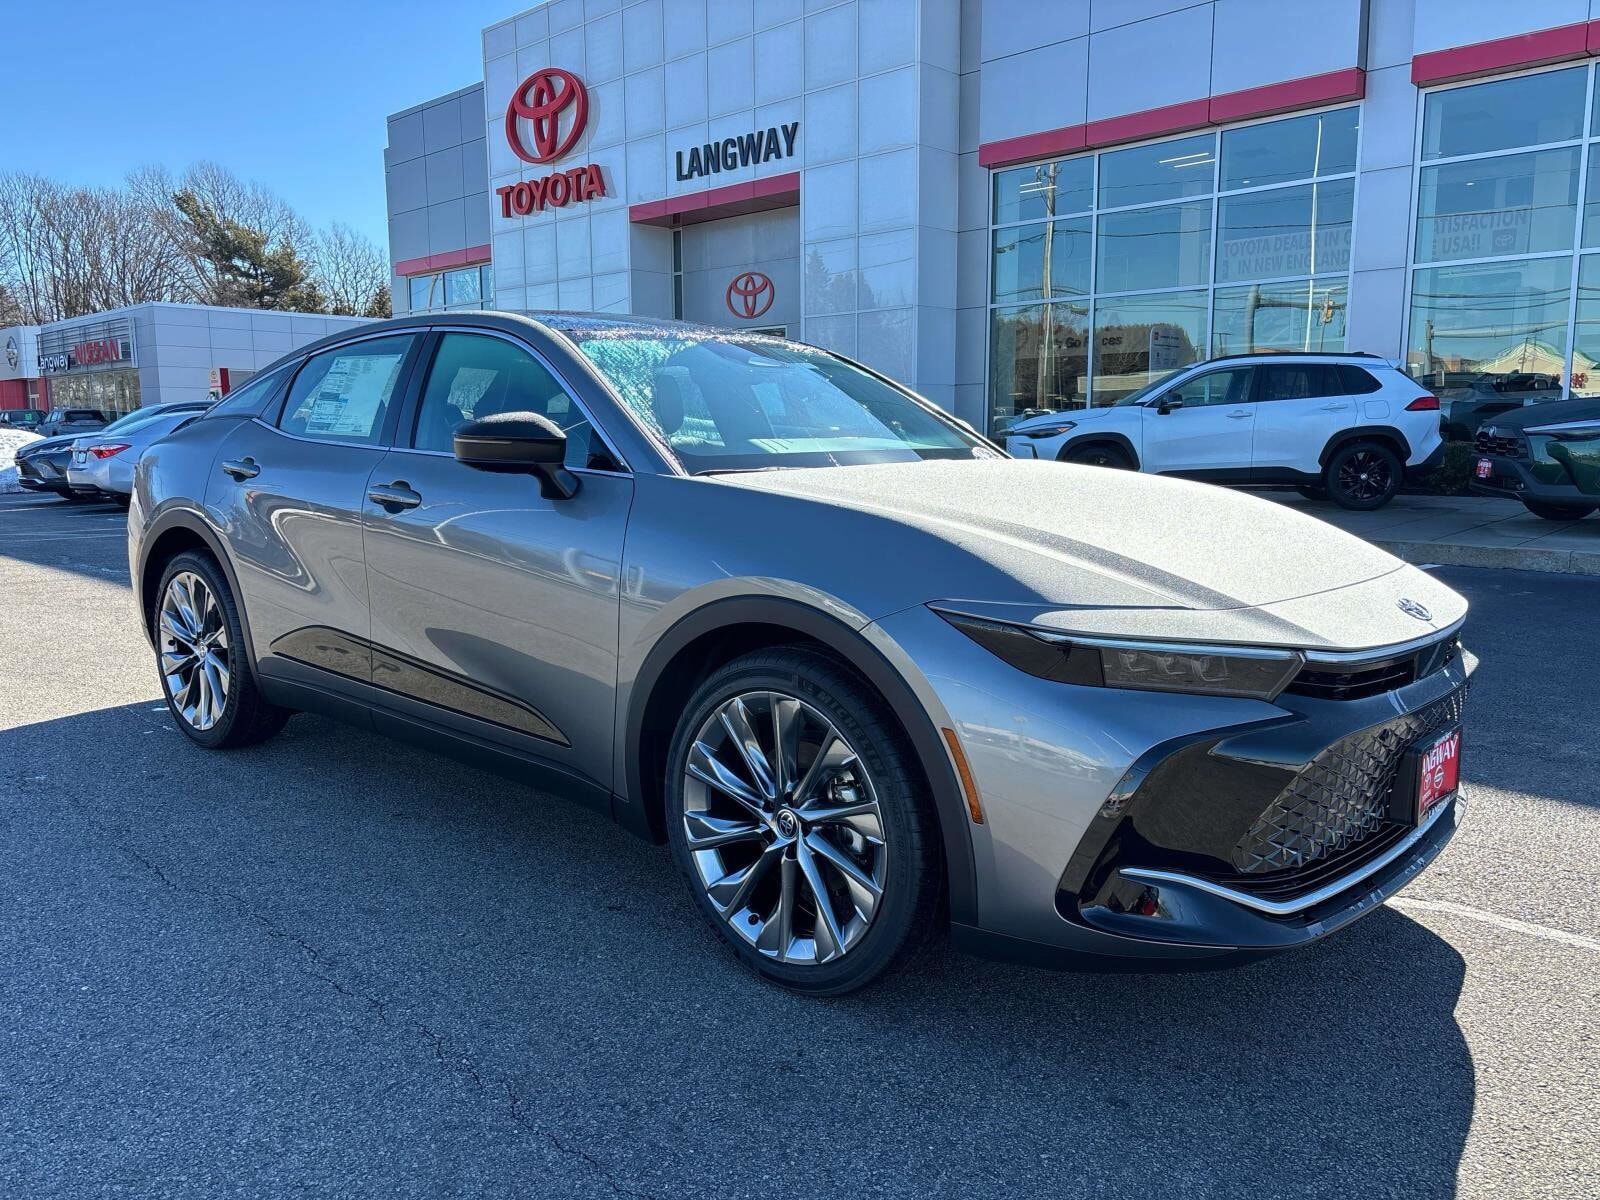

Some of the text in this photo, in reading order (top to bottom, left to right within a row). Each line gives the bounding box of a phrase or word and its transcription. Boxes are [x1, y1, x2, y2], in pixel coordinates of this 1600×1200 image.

[676, 121, 799, 182] LANGWAY
[496, 163, 608, 218] TOYOTA
[1224, 238, 1270, 258] TOYOTA
[1255, 255, 1285, 273] NEW
[1286, 249, 1351, 271] ENGLAND
[75, 337, 122, 366] NISSAN
